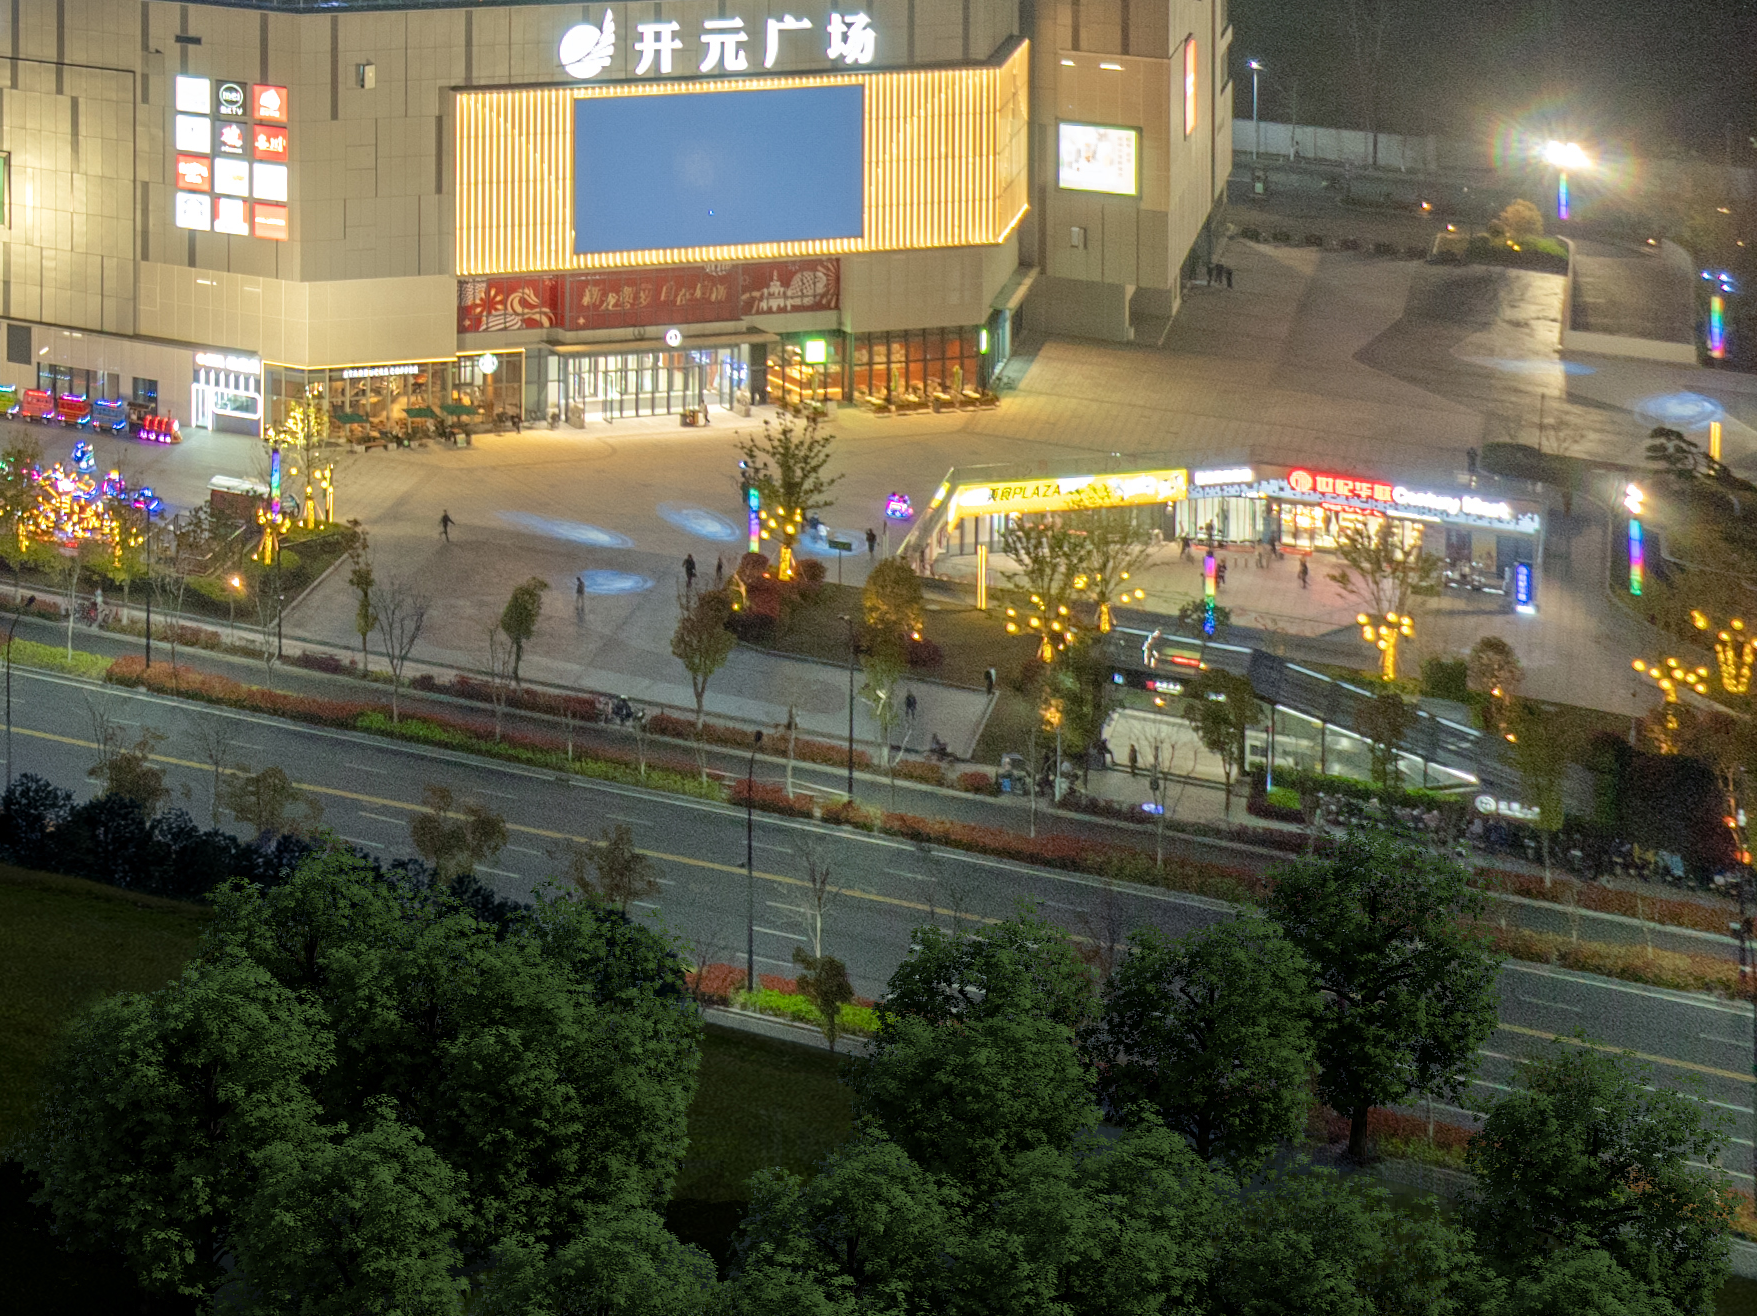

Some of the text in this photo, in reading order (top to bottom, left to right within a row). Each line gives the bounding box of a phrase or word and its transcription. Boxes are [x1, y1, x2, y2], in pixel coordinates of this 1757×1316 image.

[634, 12, 877, 74] 开元广场
[1315, 475, 1393, 502] 世纪华联
